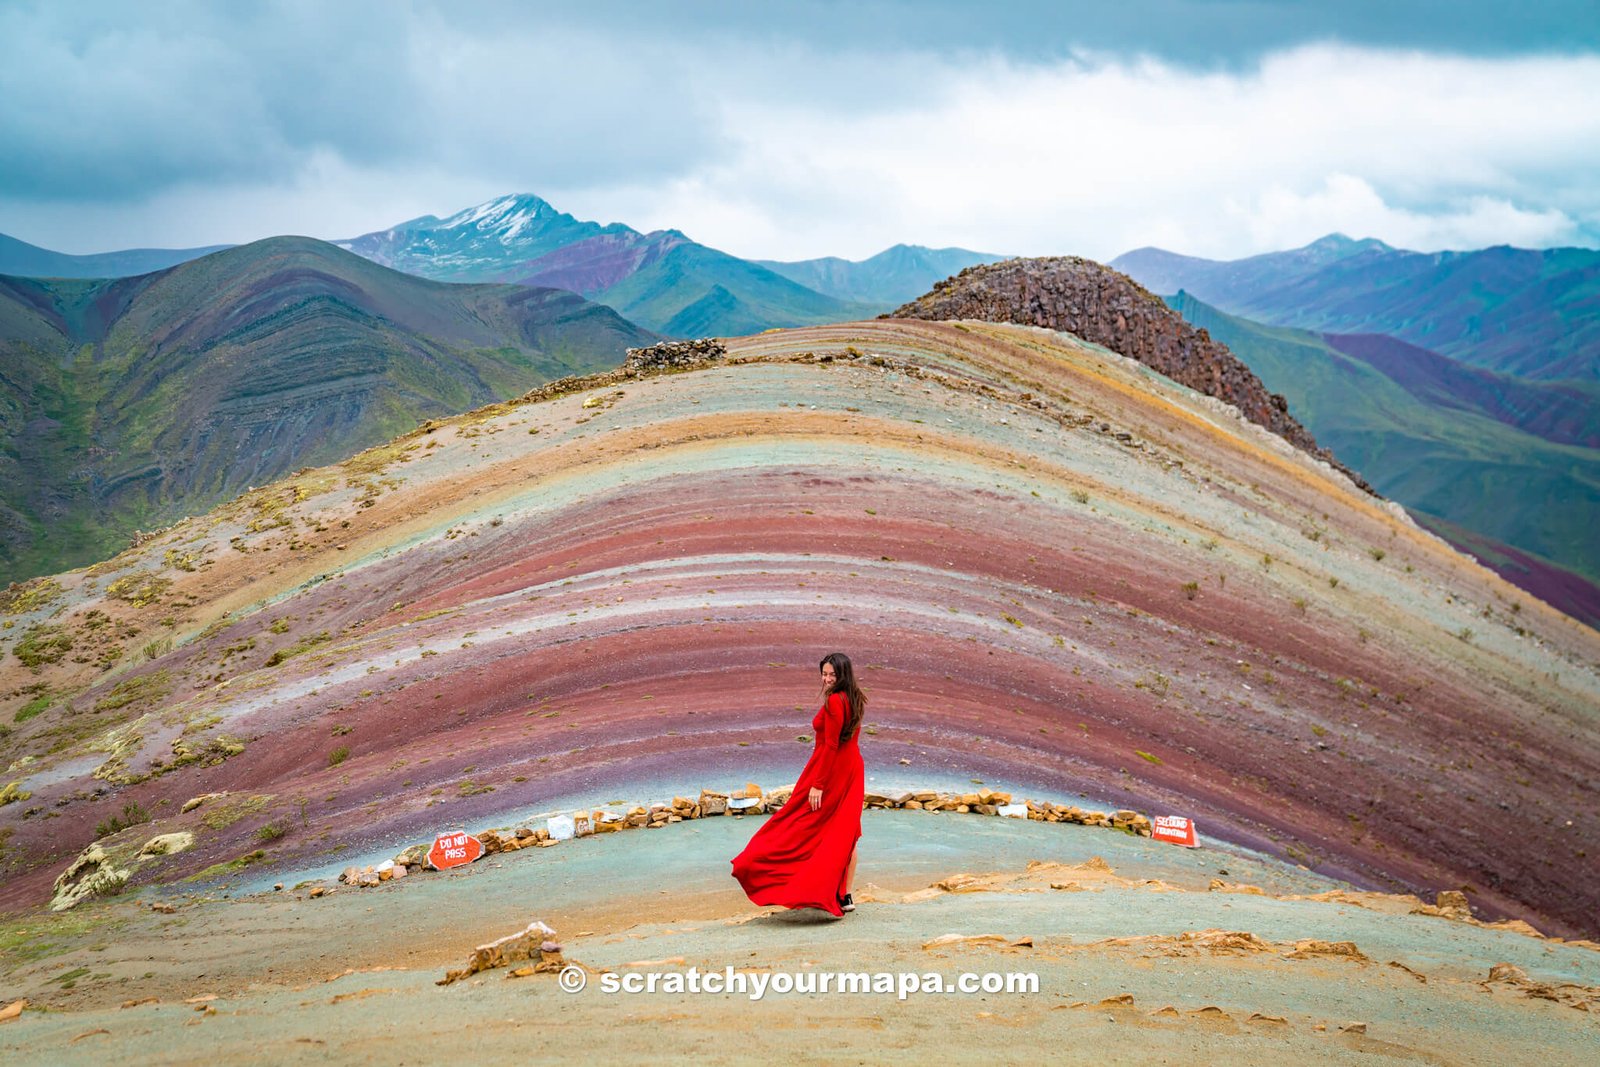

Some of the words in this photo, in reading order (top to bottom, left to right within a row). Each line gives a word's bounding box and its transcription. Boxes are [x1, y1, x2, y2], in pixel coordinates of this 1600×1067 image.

[440, 838, 452, 849] DO
[454, 835, 469, 846] NOT
[445, 848, 466, 860] PASS
